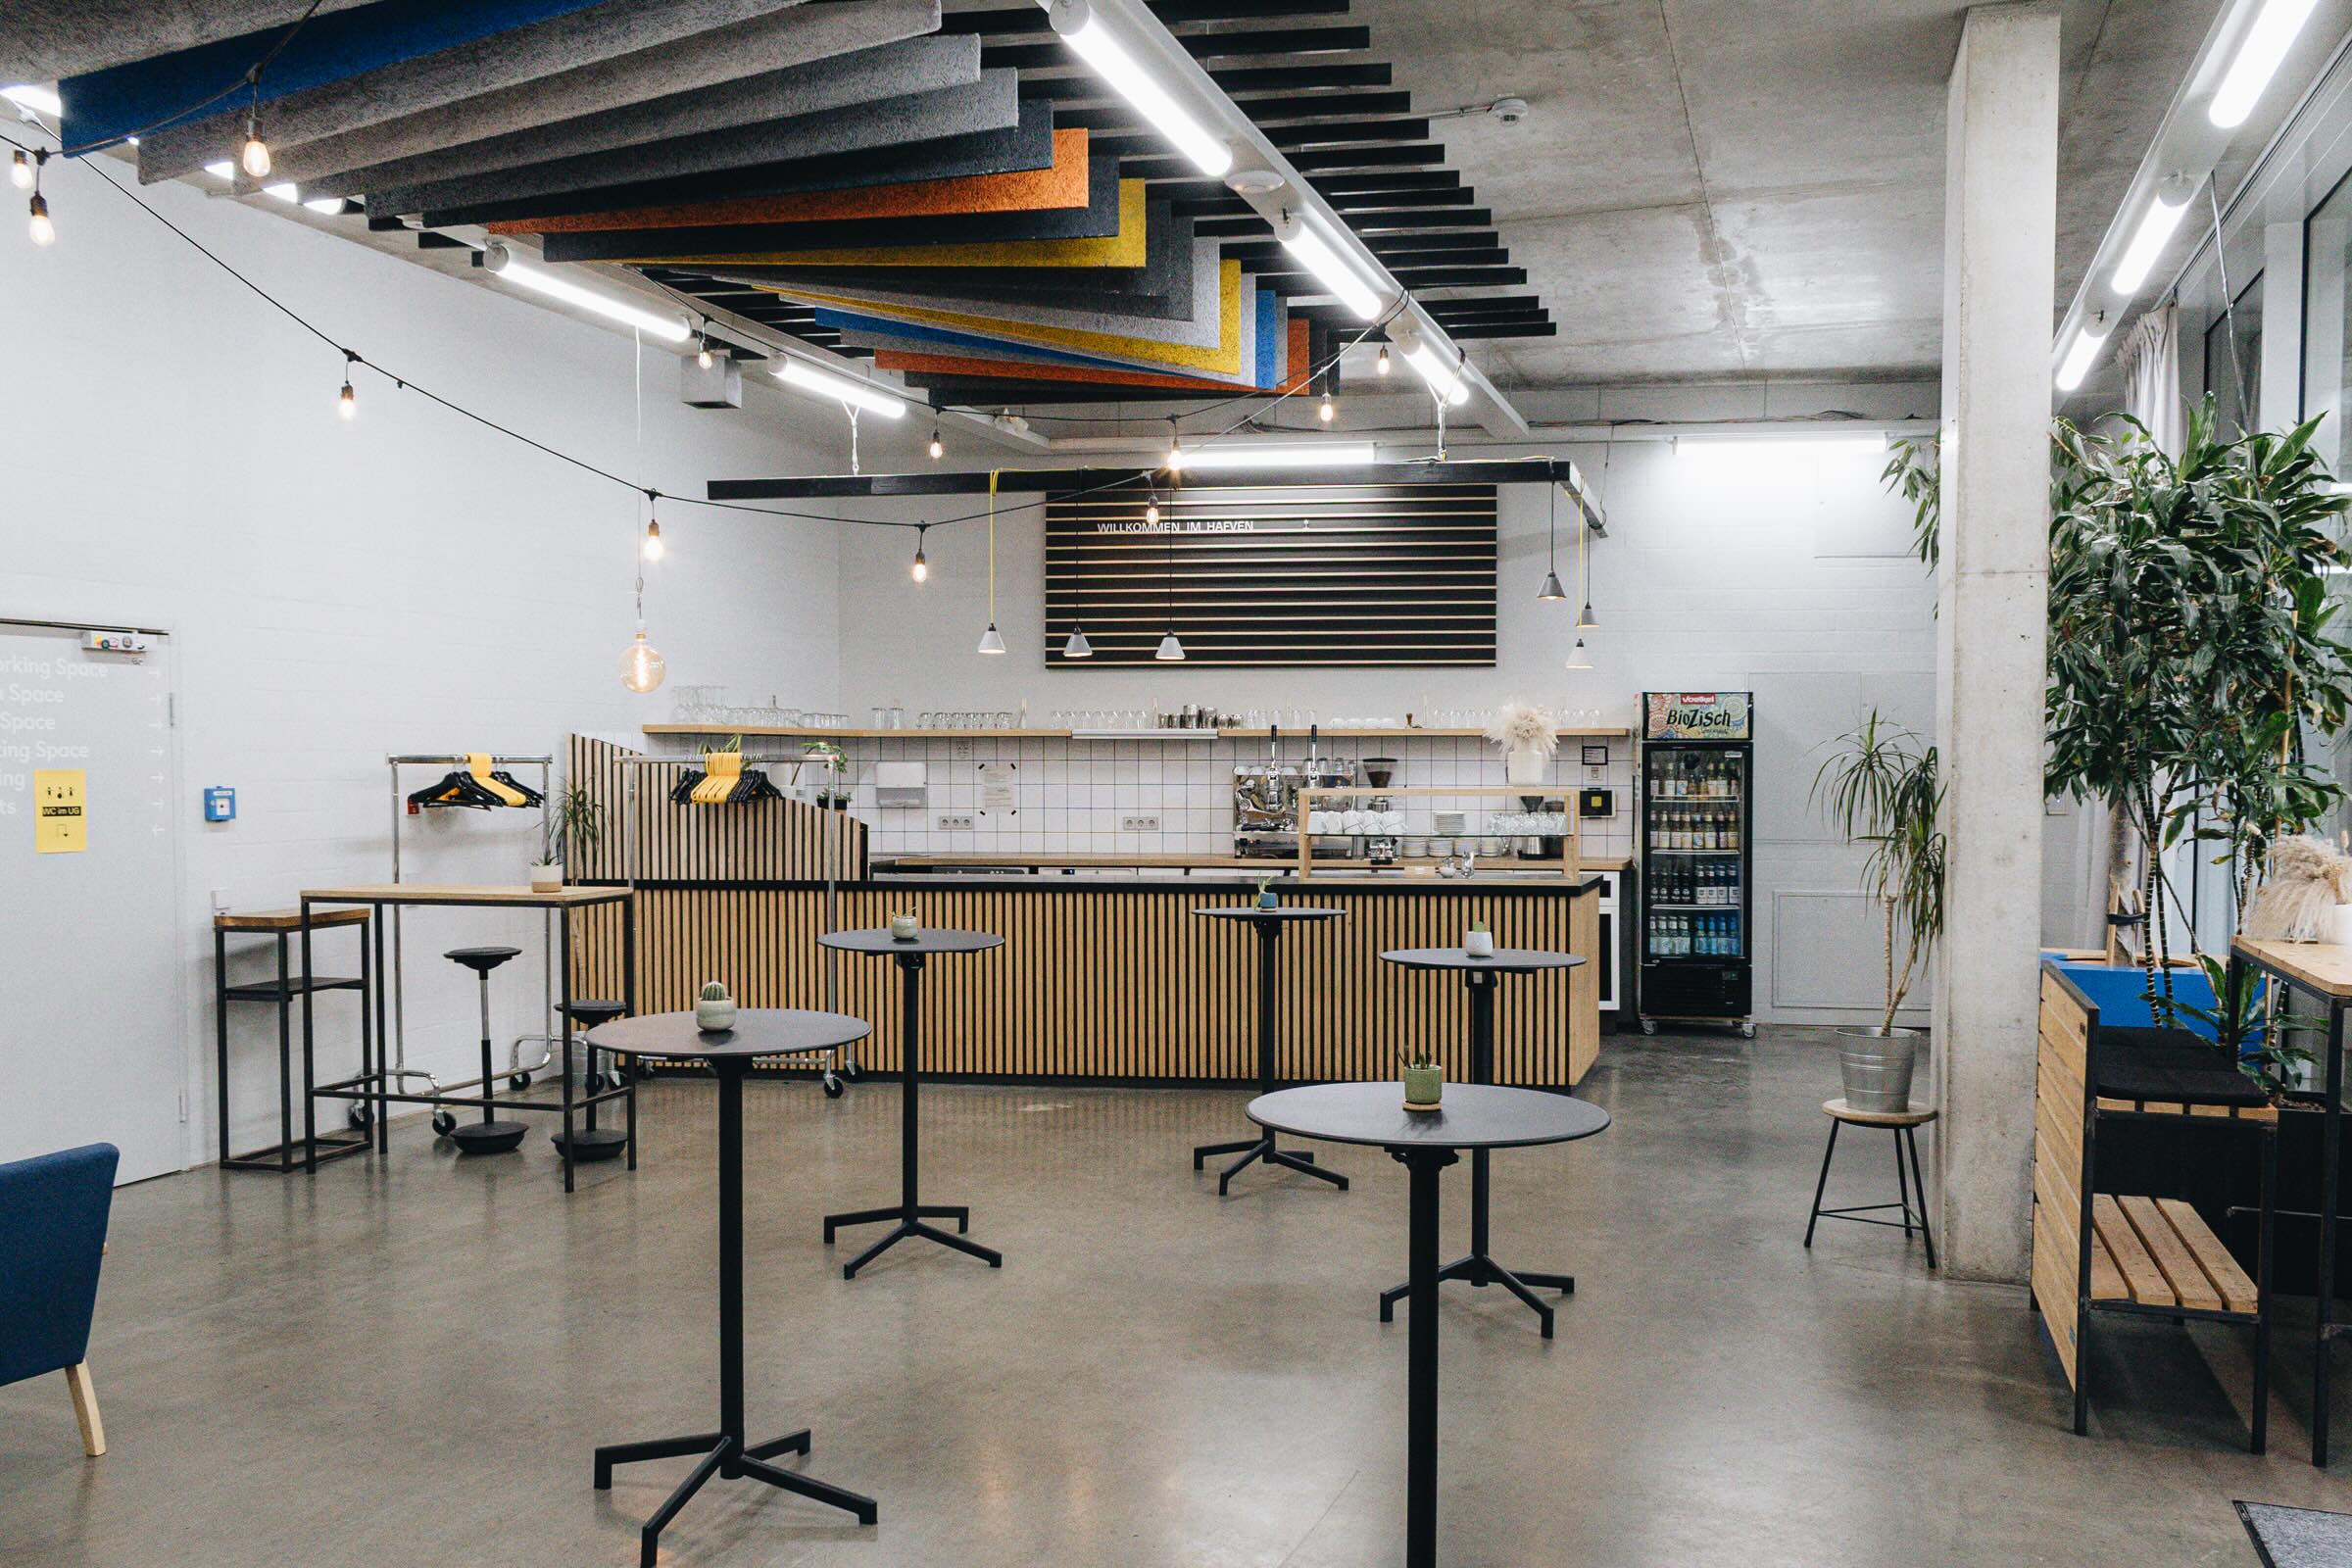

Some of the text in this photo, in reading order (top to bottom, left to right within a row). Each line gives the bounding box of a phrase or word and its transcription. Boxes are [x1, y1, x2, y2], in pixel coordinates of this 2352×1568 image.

[1098, 521, 1180, 533] WILLKOMMEN
[1187, 521, 1200, 533] IM
[56, 658, 109, 681] Space
[9, 683, 65, 706] Space
[0, 711, 56, 734] Space
[36, 741, 89, 763] Space
